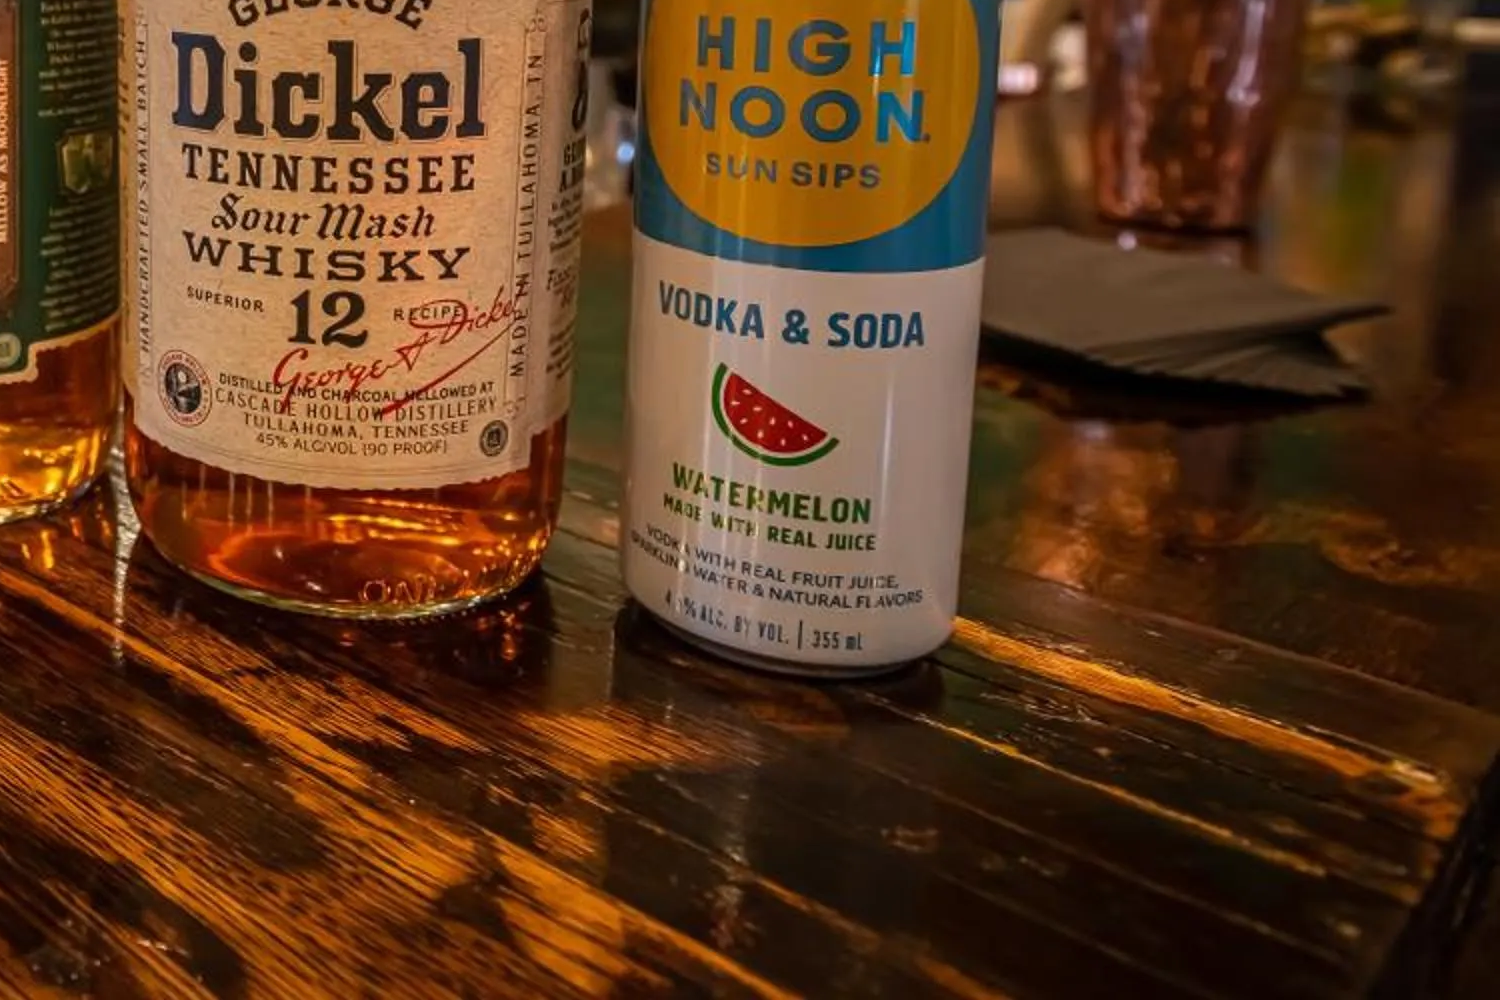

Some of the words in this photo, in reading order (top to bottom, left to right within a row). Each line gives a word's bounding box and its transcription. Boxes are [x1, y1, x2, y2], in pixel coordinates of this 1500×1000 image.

[697, 15, 918, 78] HIGH
[171, 31, 487, 142] Dickel
[679, 77, 927, 144] NOON
[182, 143, 476, 194] TENNESSEE
[705, 152, 778, 183] SUN
[790, 161, 881, 190] SIPS
[212, 192, 311, 235] Sour
[316, 202, 435, 240] Mash
[510, 308, 529, 376] MADE
[526, 55, 543, 86] TN
[182, 230, 471, 283] WHISKY
[186, 285, 264, 312] SUPERIOR
[287, 289, 368, 348] 12
[393, 305, 462, 321] RECIPE
[658, 279, 764, 340] VODKA
[781, 308, 810, 346] &
[826, 311, 926, 348] SODA
[216, 388, 297, 416] CASCADE
[307, 403, 384, 422] HOLLOW
[396, 396, 497, 421] DISTILLERY
[219, 372, 282, 394] DISTILLED
[321, 388, 397, 402] CHARCOAL
[479, 381, 495, 394] AT
[273, 347, 389, 413] George
[244, 412, 364, 440] TULLAHOMA,
[371, 420, 469, 439] TENNESSEE
[256, 432, 289, 448] 45%
[671, 461, 873, 525] WATERMELON
[662, 493, 703, 522] MADE
[711, 511, 758, 537] WITH
[767, 526, 817, 549] REAL
[825, 533, 877, 551] JUICE
[695, 546, 736, 571] WITH
[740, 561, 786, 583] REAL
[791, 571, 844, 588] FRUIT
[768, 587, 852, 609] NATURAL
[855, 590, 924, 609] FLAVORS
[758, 621, 789, 645] VOL.
[812, 630, 840, 649] 355
